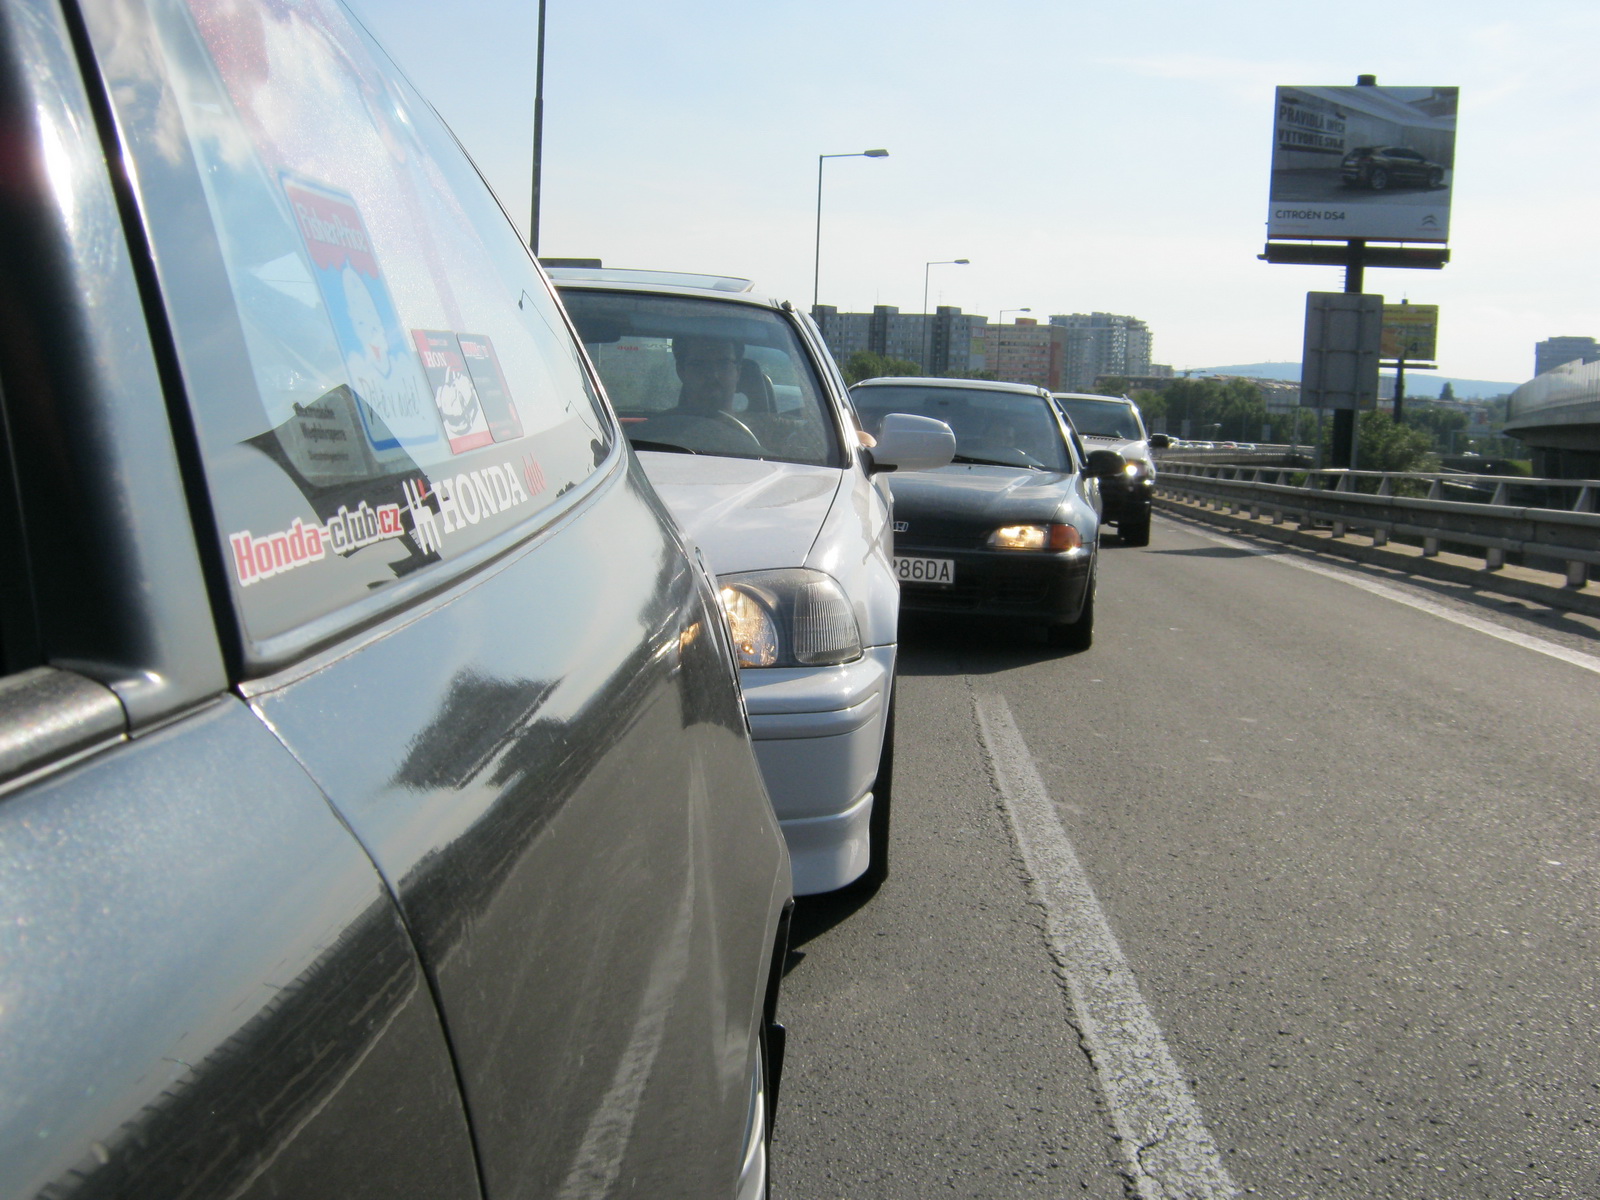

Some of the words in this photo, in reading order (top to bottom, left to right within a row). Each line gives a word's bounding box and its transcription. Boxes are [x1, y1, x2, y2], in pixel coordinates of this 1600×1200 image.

[1275, 208, 1321, 220] CITROËN
[1324, 210, 1345, 220] DS4
[429, 461, 529, 535] HONDA
[231, 504, 403, 583] Honda-club.cz
